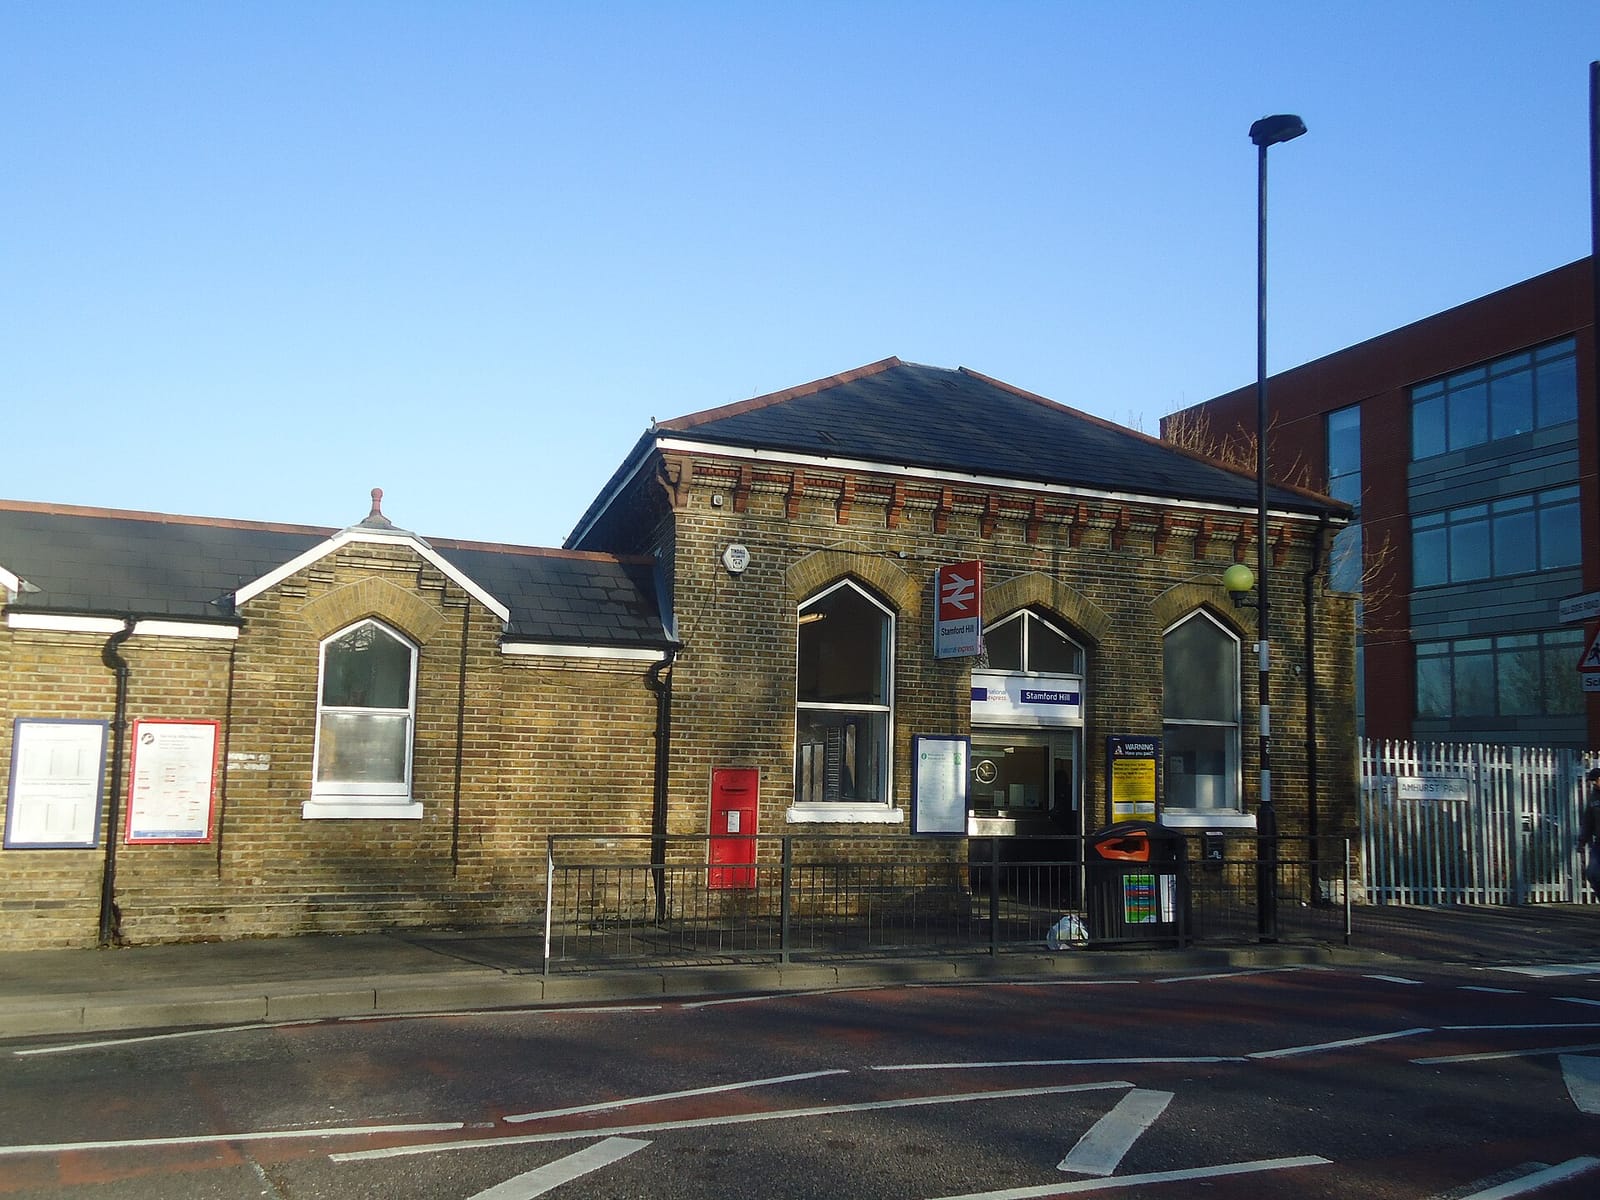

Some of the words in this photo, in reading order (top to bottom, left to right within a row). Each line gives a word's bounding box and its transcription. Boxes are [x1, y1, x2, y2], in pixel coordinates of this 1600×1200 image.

[941, 627, 964, 636] Stamford
[966, 625, 975, 633] Hill
[1026, 692, 1058, 701] Stamford
[1059, 693, 1071, 701] Hill
[1125, 743, 1154, 751] WARNING
[1402, 783, 1440, 793] AMHURST
[1443, 784, 1465, 793] PARK
